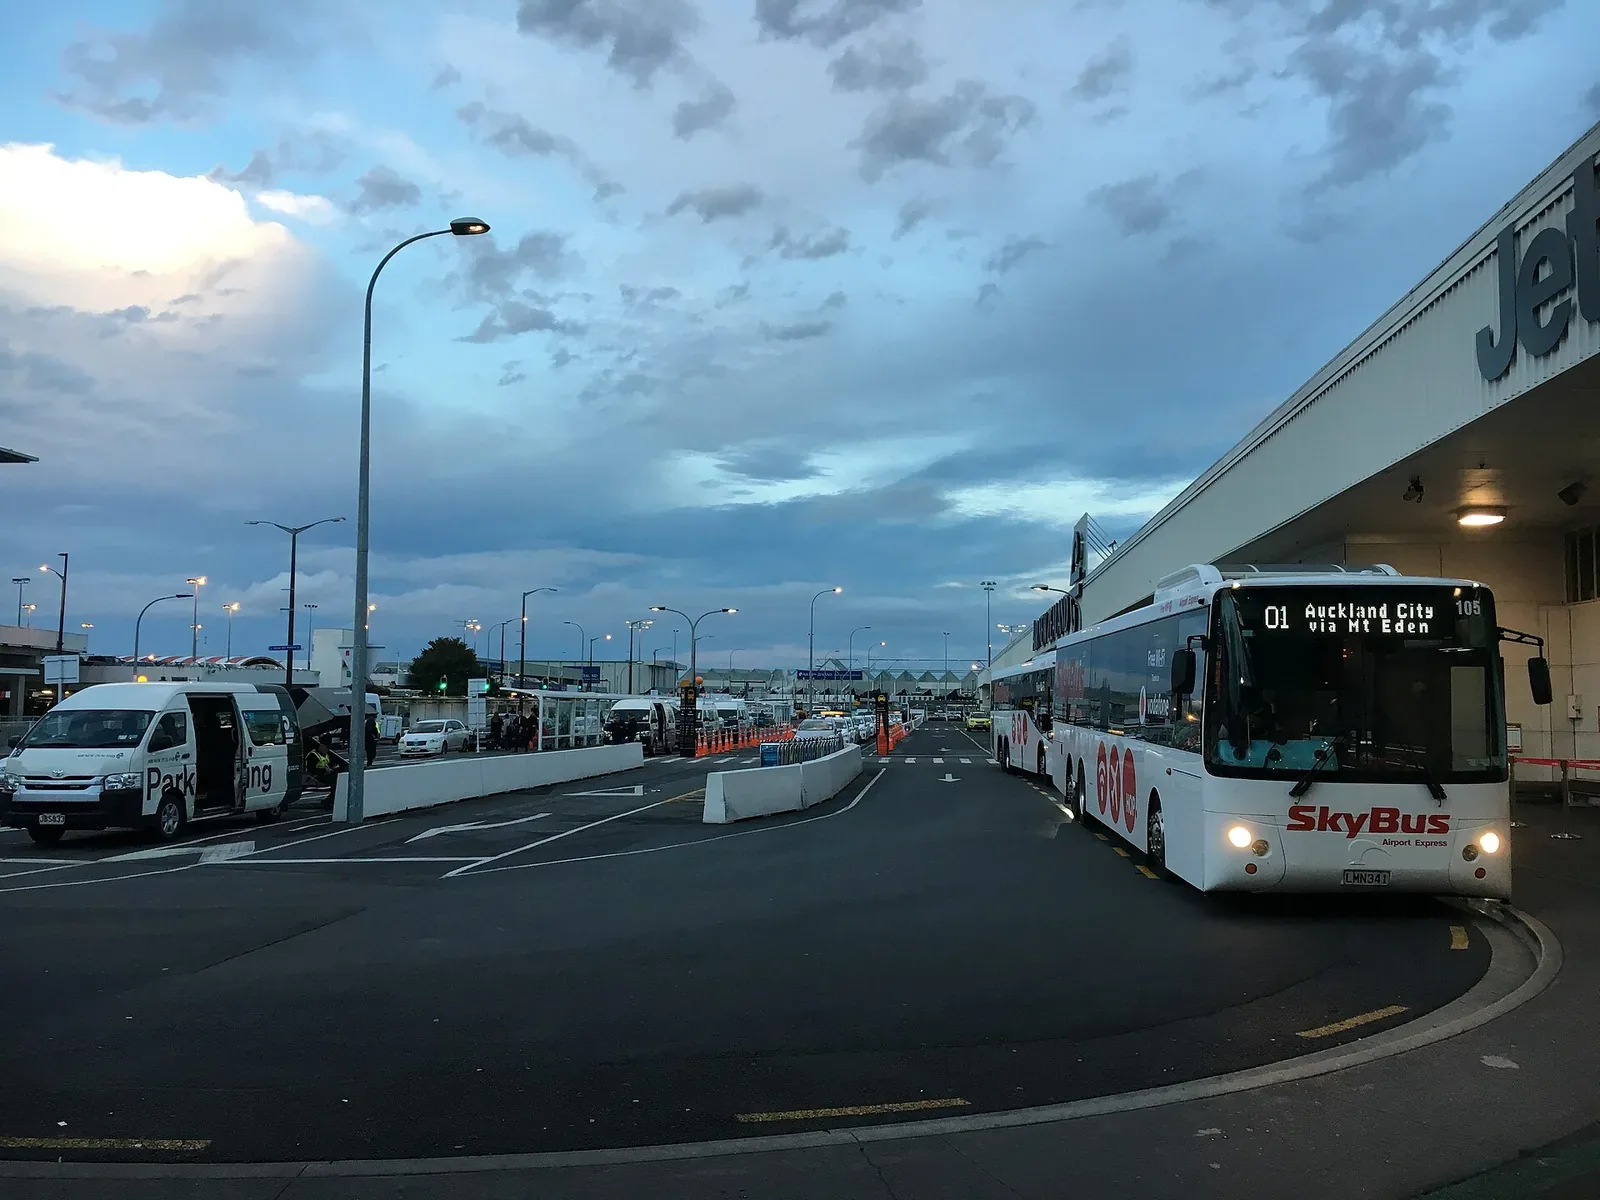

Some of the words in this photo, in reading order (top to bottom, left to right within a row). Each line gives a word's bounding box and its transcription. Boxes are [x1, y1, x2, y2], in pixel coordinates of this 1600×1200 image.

[1305, 603, 1388, 619] Auckland
[1397, 603, 1434, 619] City
[1455, 600, 1481, 616] 105
[1264, 605, 1289, 629] 01
[1309, 619, 1337, 633] via
[1348, 619, 1370, 633] Mt
[1381, 619, 1429, 633] Eden
[1286, 805, 1451, 839] SkyBus
[1382, 838, 1411, 848] Airport
[1415, 839, 1448, 848] Express
[1344, 871, 1389, 885] LMN341
